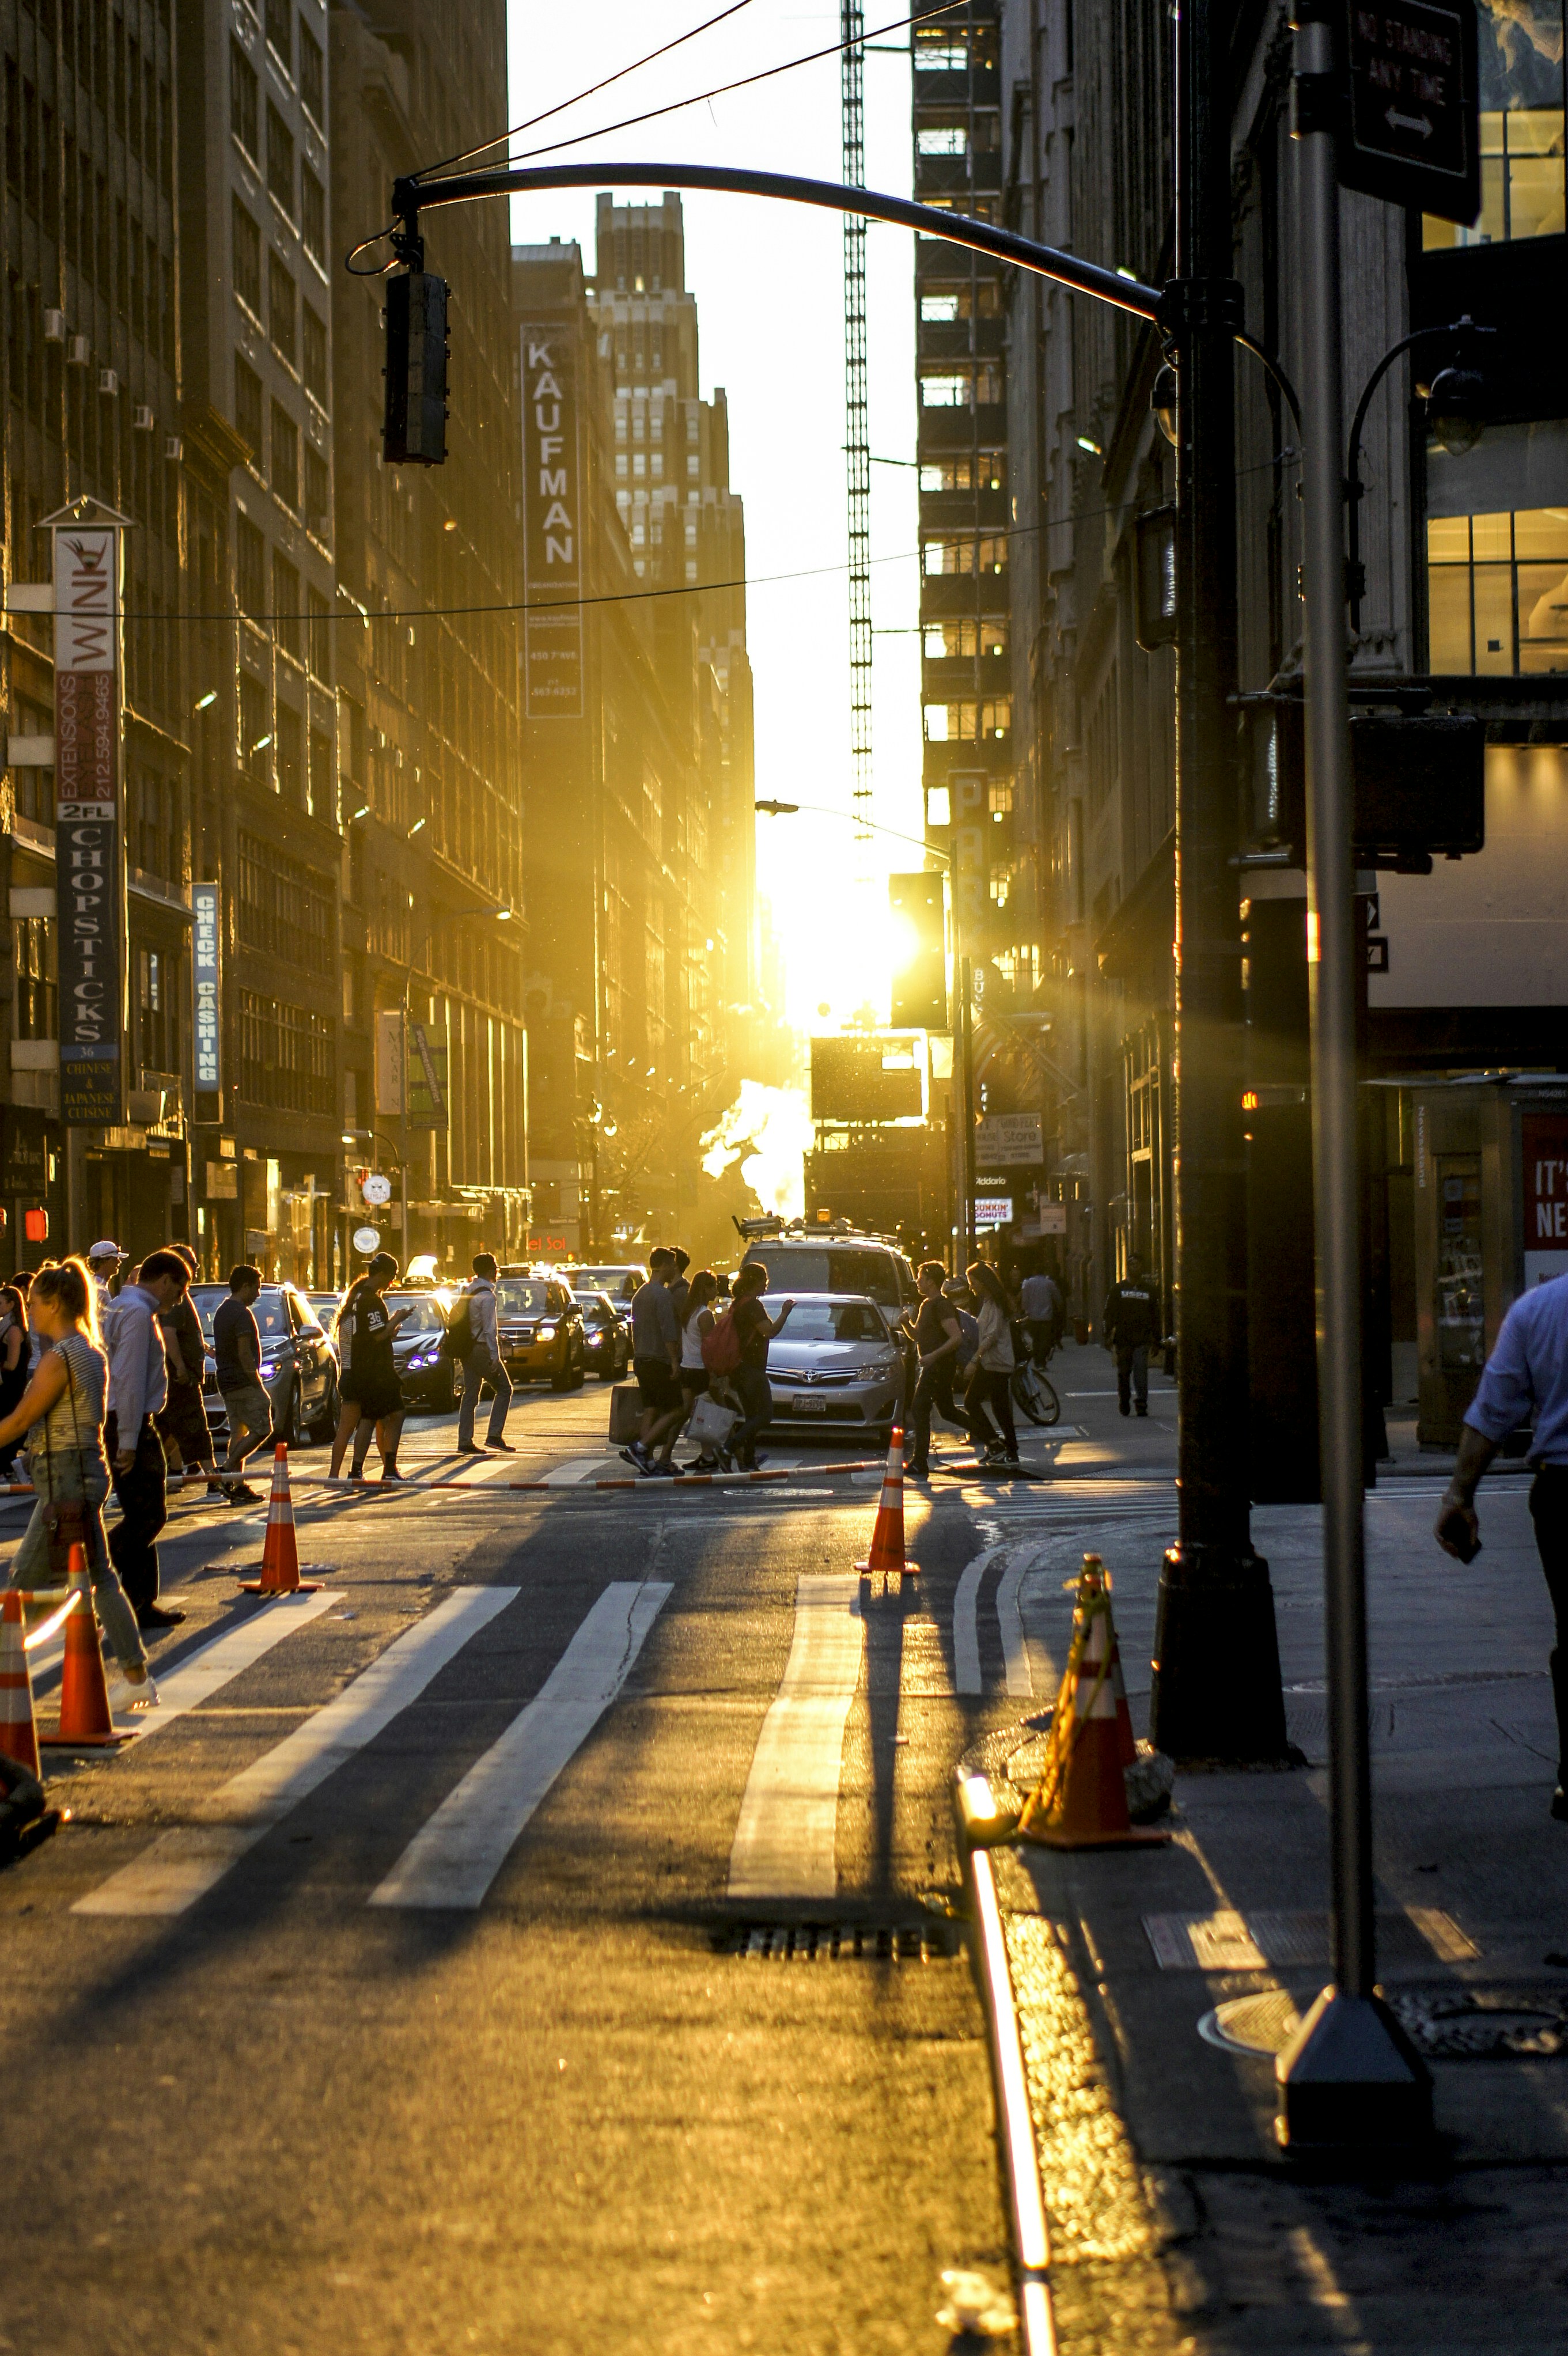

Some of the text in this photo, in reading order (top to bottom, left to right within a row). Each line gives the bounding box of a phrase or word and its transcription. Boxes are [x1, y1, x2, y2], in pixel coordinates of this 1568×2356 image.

[1384, 18, 1452, 67] STANDING
[1369, 56, 1402, 92] ANY
[528, 342, 573, 563] KAUFMAN
[60, 536, 108, 666] WINK
[60, 675, 77, 799] EXTENSIONS
[96, 675, 111, 799] 212.594.9465
[62, 805, 109, 819] 2FL
[70, 828, 104, 1043] CHOPSTICKS
[196, 895, 217, 1081] CHECK CASHING
[66, 1062, 111, 1074] CHINESE
[81, 1046, 94, 1058] 36
[64, 1092, 115, 1104] JAPANESE
[85, 1077, 93, 1089] &
[67, 1106, 112, 1118] CUISINE
[1003, 1130, 1037, 1143] Store
[1418, 1105, 1426, 1188] Newsstand
[1535, 1160, 1568, 1198] IT'
[546, 1235, 566, 1251] Sol
[367, 1310, 382, 1324] 36
